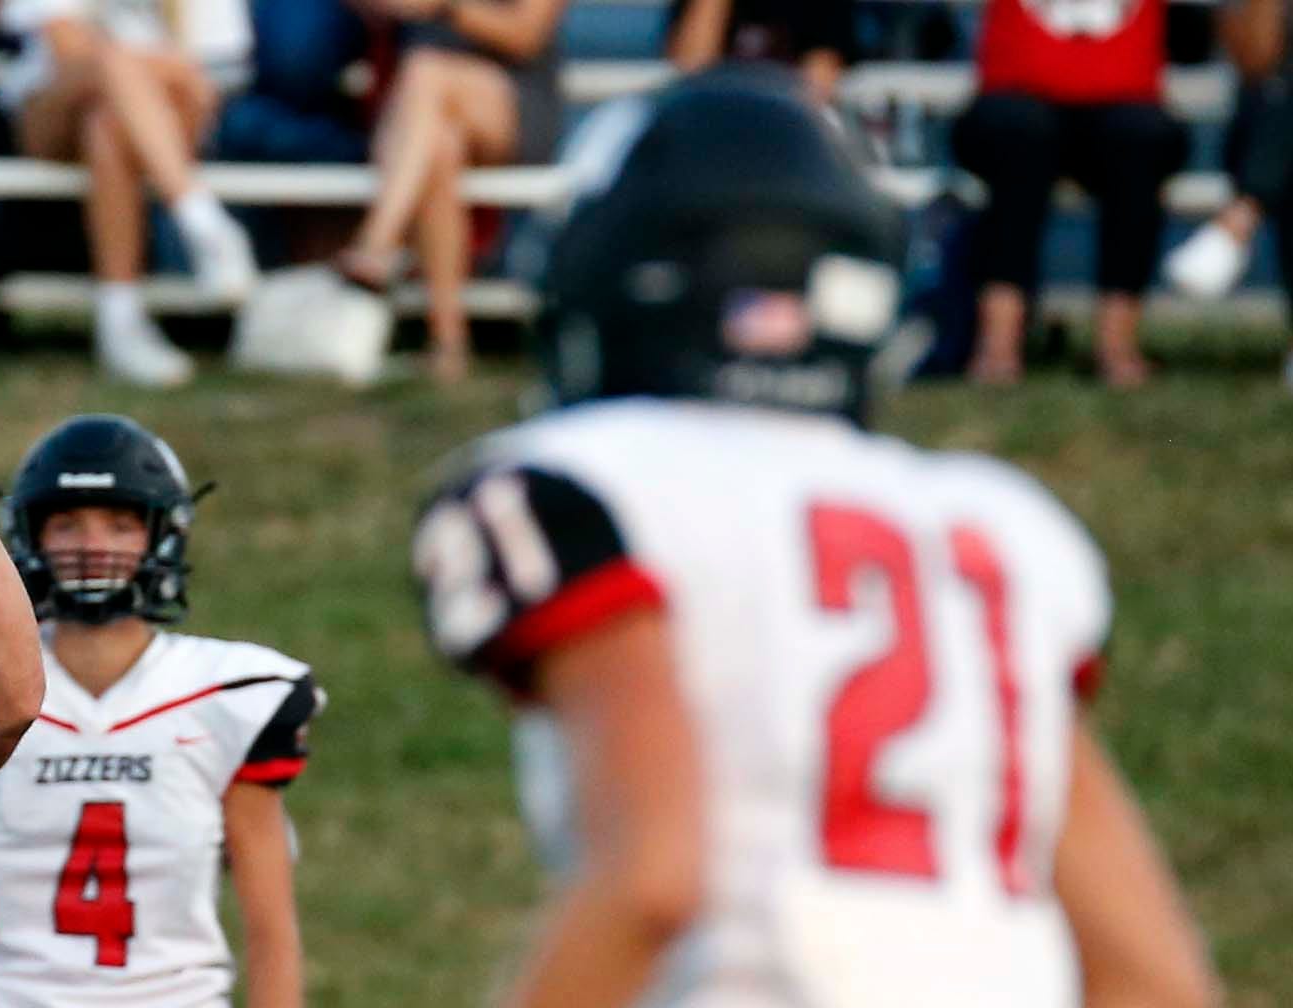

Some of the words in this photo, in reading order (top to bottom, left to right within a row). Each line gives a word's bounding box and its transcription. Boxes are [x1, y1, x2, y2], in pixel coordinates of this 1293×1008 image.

[37, 756, 152, 783] ZIZZERS
[805, 500, 1033, 893] 21
[53, 802, 135, 967] 4
